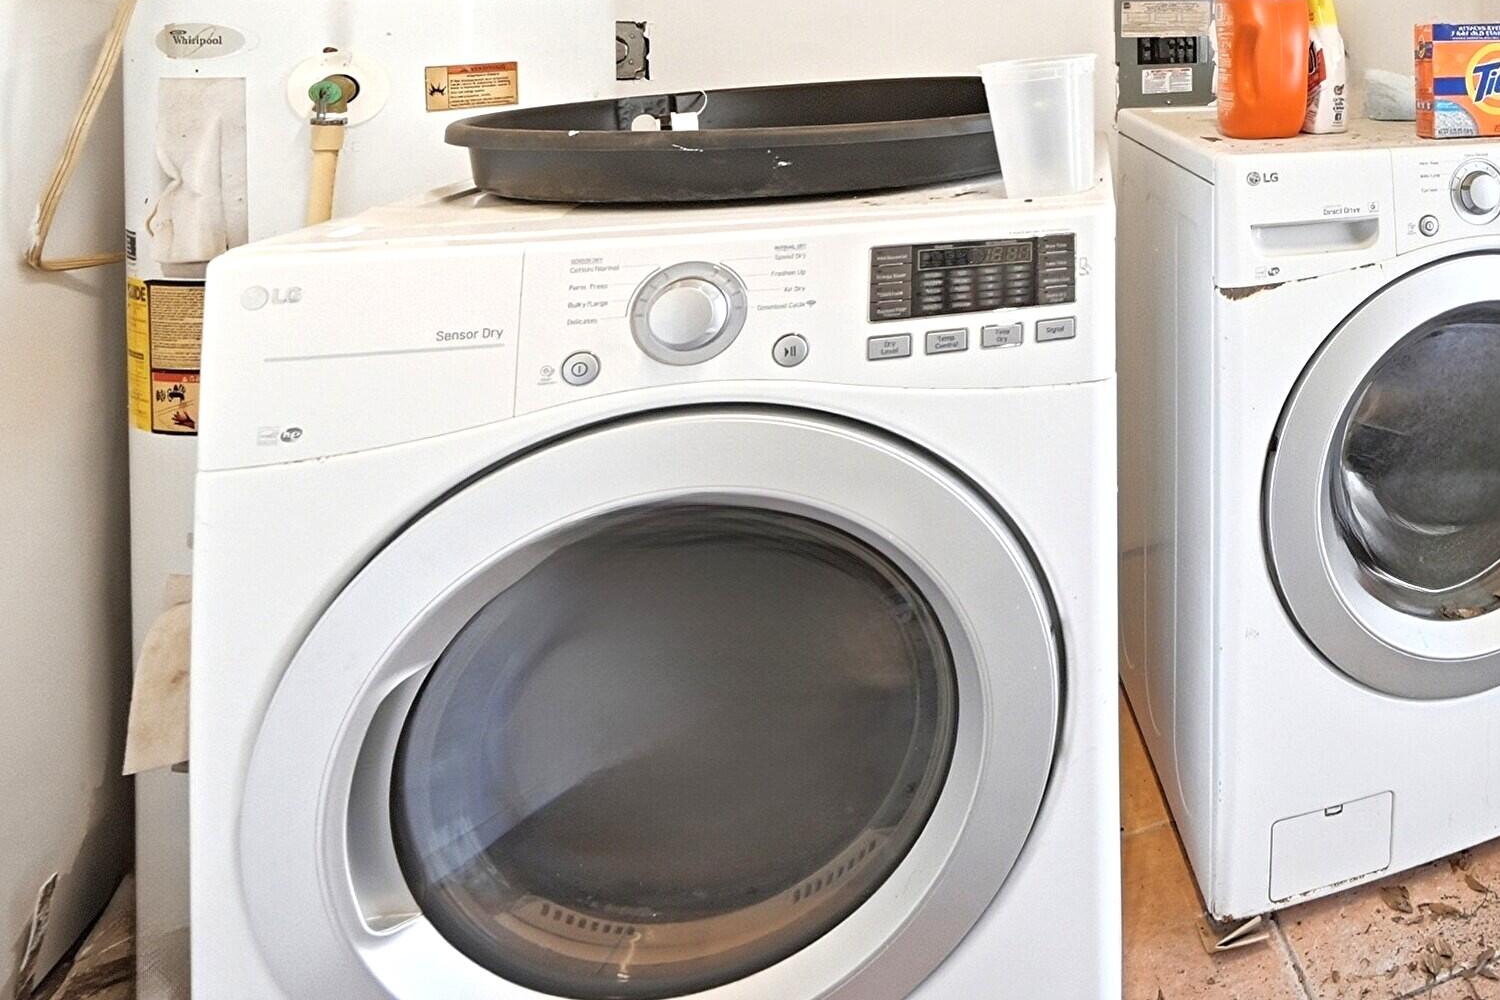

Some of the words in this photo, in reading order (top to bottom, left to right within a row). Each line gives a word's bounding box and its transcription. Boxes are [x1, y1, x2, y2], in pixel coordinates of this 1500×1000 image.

[172, 35, 223, 47] Whirlpool
[271, 286, 303, 305] LG
[435, 330, 480, 342] Sensor
[482, 327, 504, 340] Dry
